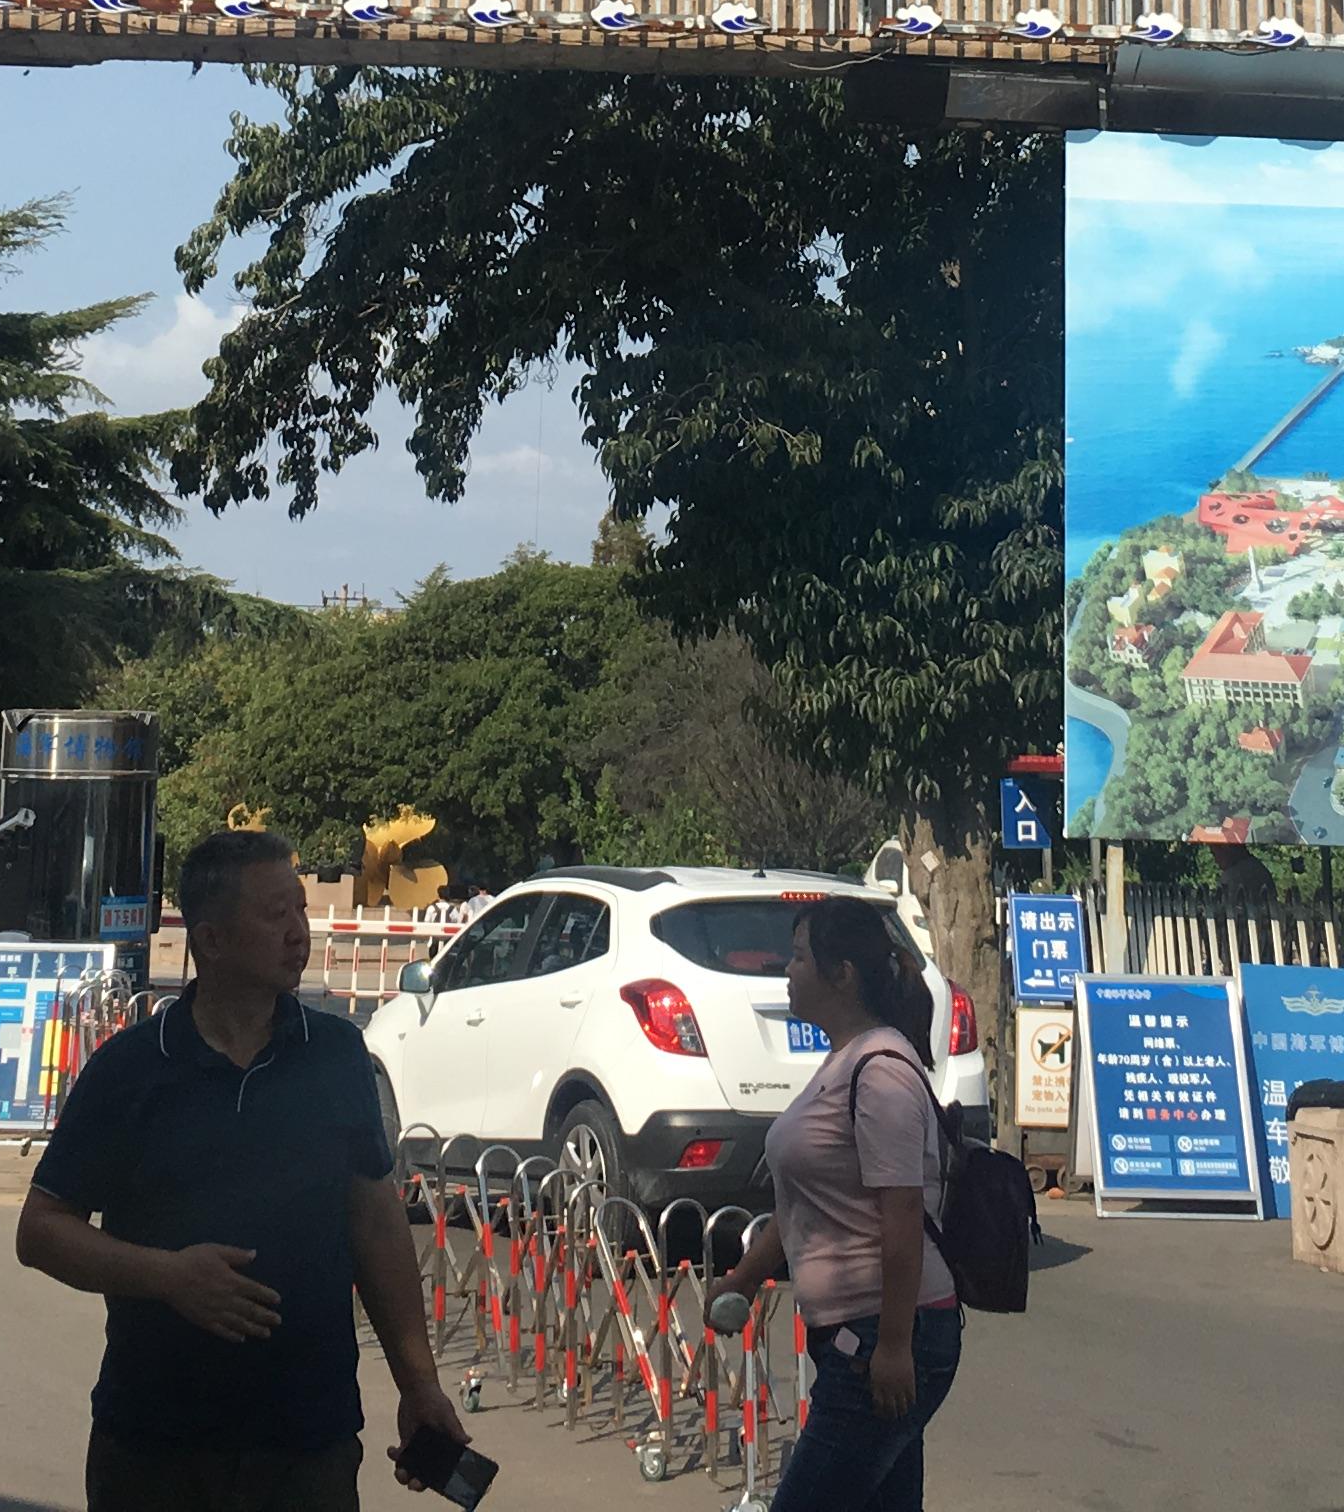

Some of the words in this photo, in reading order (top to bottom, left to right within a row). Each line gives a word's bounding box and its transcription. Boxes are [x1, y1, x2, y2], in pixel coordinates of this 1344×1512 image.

[1014, 789, 1037, 842] 入口
[1020, 911, 1075, 931] 请出示
[1032, 939, 1069, 960] 门票
[1128, 1014, 1189, 1028] 温馨提示
[1268, 1155, 1292, 1184] 敬
